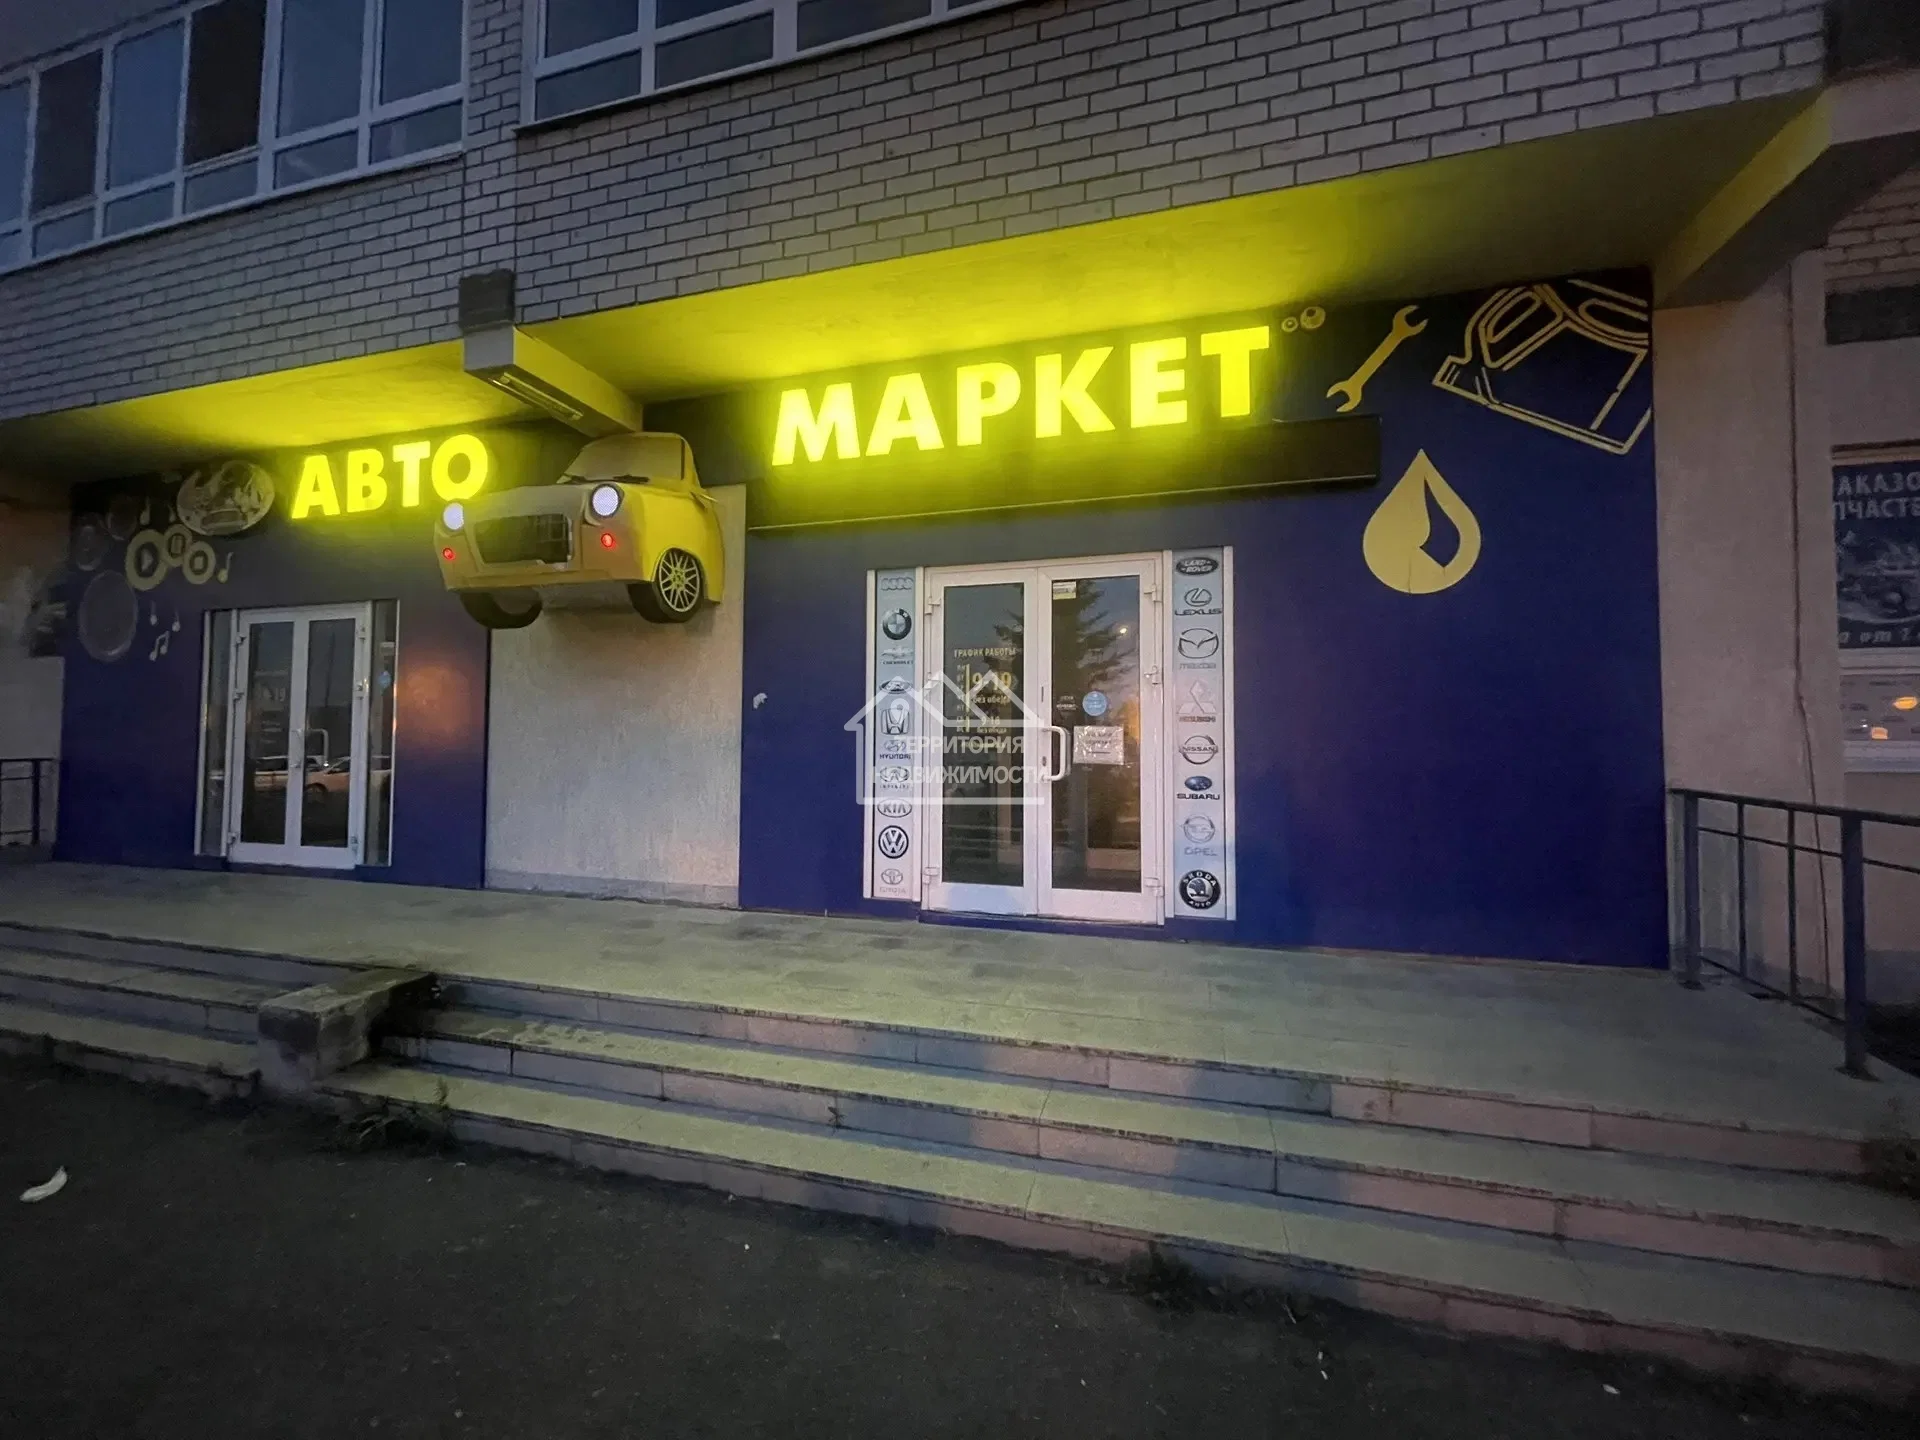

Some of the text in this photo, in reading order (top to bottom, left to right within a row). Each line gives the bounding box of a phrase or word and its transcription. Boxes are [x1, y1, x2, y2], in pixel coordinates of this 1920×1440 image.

[772, 326, 1270, 466] МАРКЕТ
[292, 434, 488, 519] АВТО
[1175, 608, 1222, 616] LEXUS
[883, 803, 907, 813] KIA
[1184, 847, 1217, 857] OPEL
